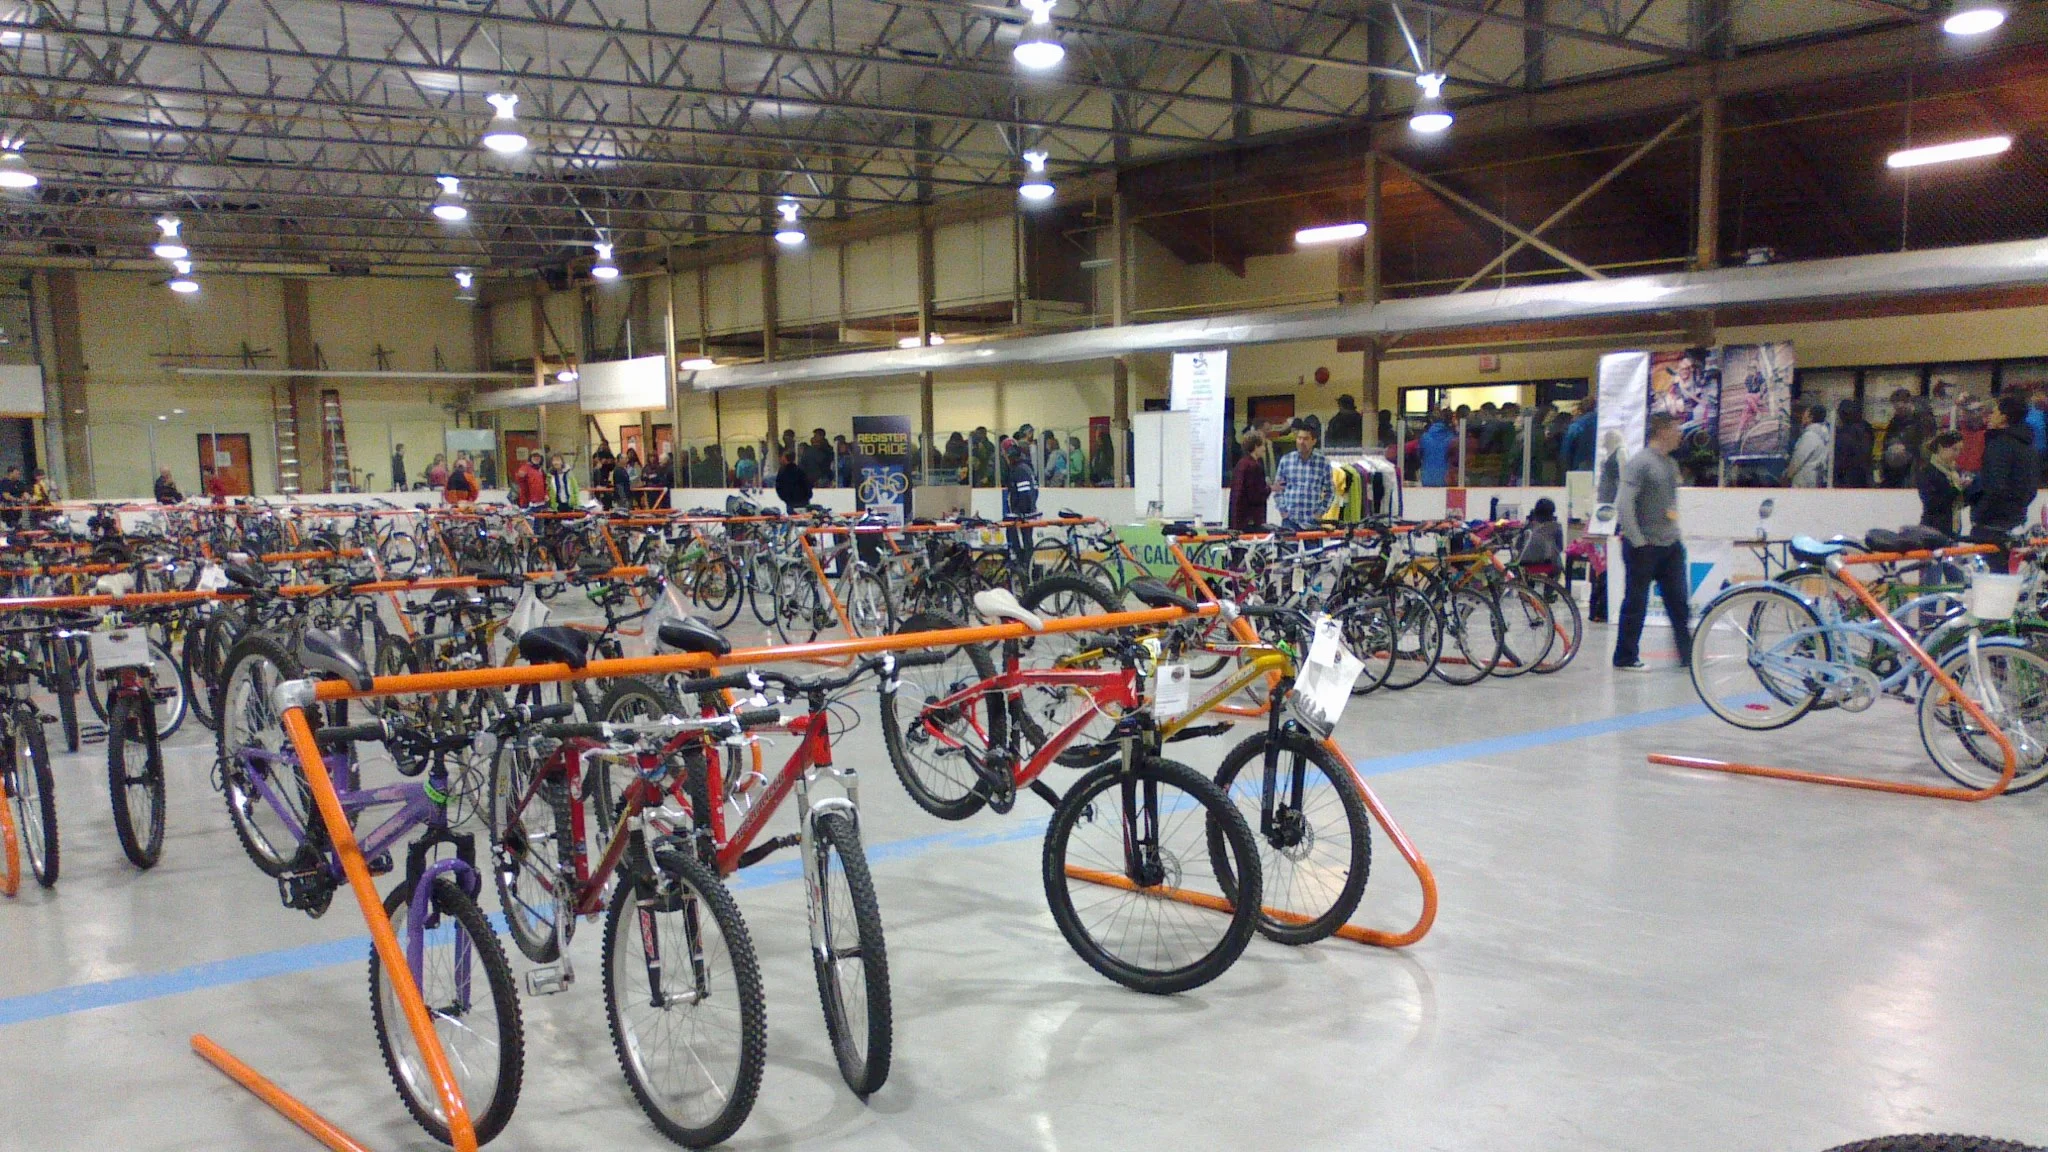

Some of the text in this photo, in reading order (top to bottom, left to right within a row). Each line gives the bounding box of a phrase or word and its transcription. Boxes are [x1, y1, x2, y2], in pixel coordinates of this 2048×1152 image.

[857, 433, 907, 443] REGISTER
[859, 443, 907, 455] TO RIDE
